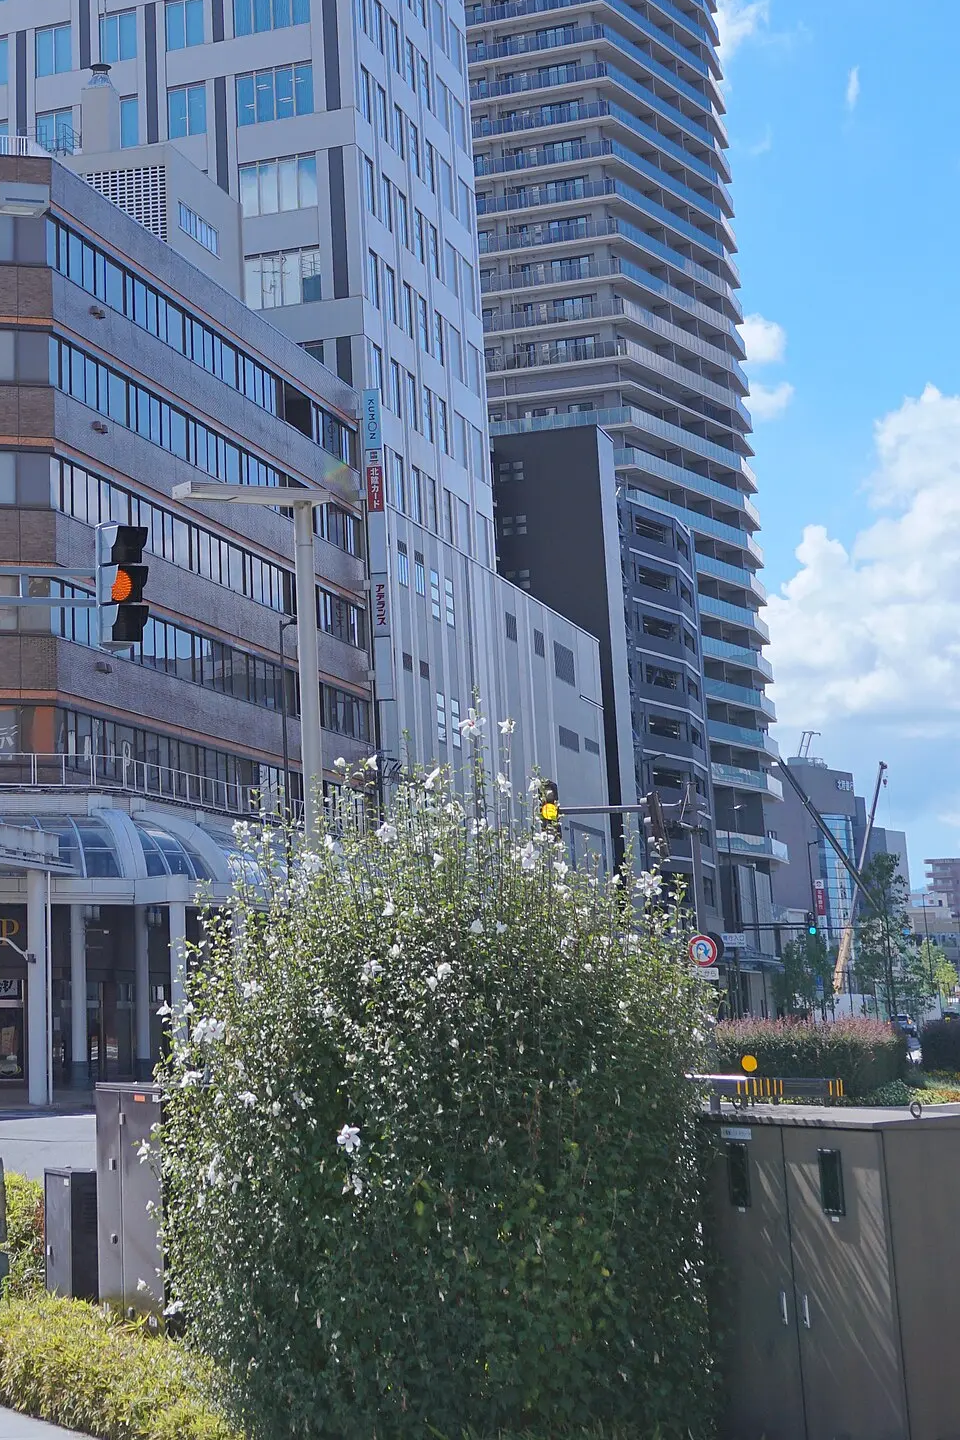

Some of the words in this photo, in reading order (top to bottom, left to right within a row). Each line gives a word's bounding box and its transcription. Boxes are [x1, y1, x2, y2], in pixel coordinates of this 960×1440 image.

[368, 398, 377, 440] KUMON
[370, 467, 380, 509] 北陸カード
